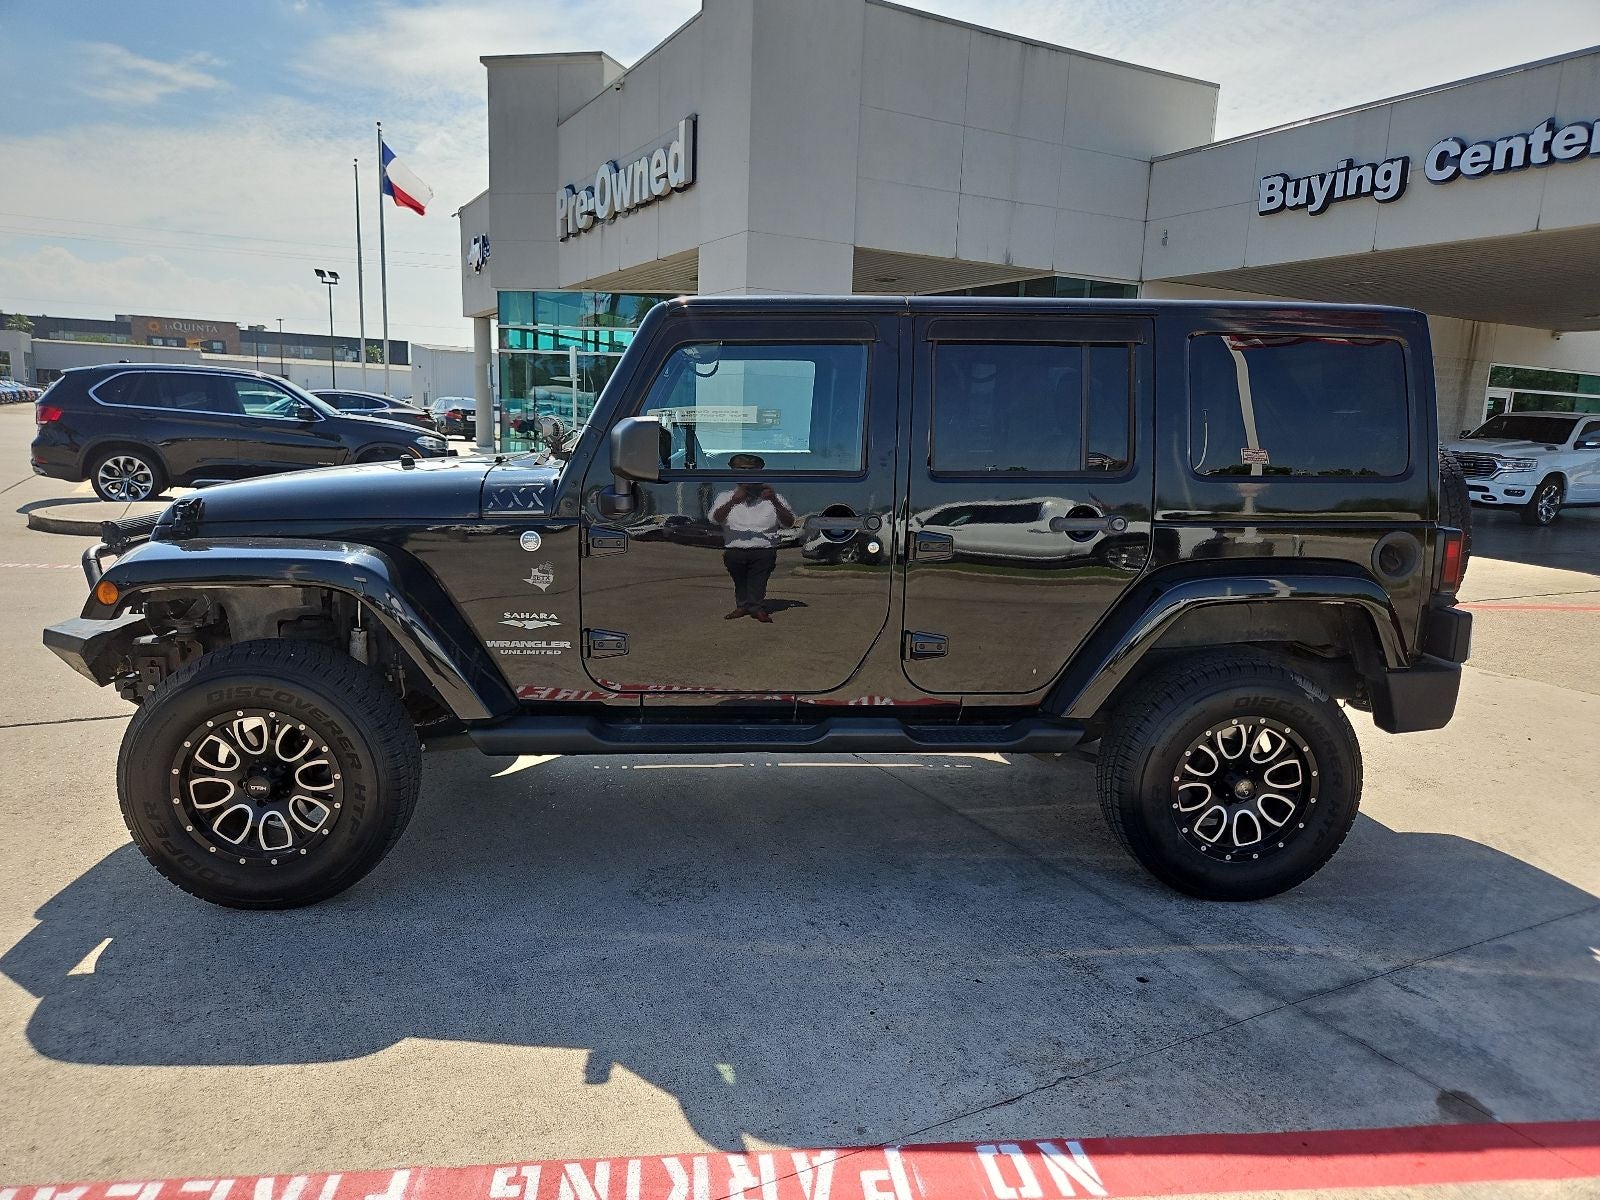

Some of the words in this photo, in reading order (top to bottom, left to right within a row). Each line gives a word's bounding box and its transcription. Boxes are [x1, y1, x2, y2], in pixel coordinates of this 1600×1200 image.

[556, 116, 697, 240] Pre-Owned
[1258, 159, 1409, 215] Buying
[503, 611, 559, 620] SAHARA
[485, 640, 571, 649] WRANGLER
[205, 686, 363, 771] DISCOVERER
[488, 1148, 914, 1200] PARKING
[975, 1141, 1108, 1199] NO
